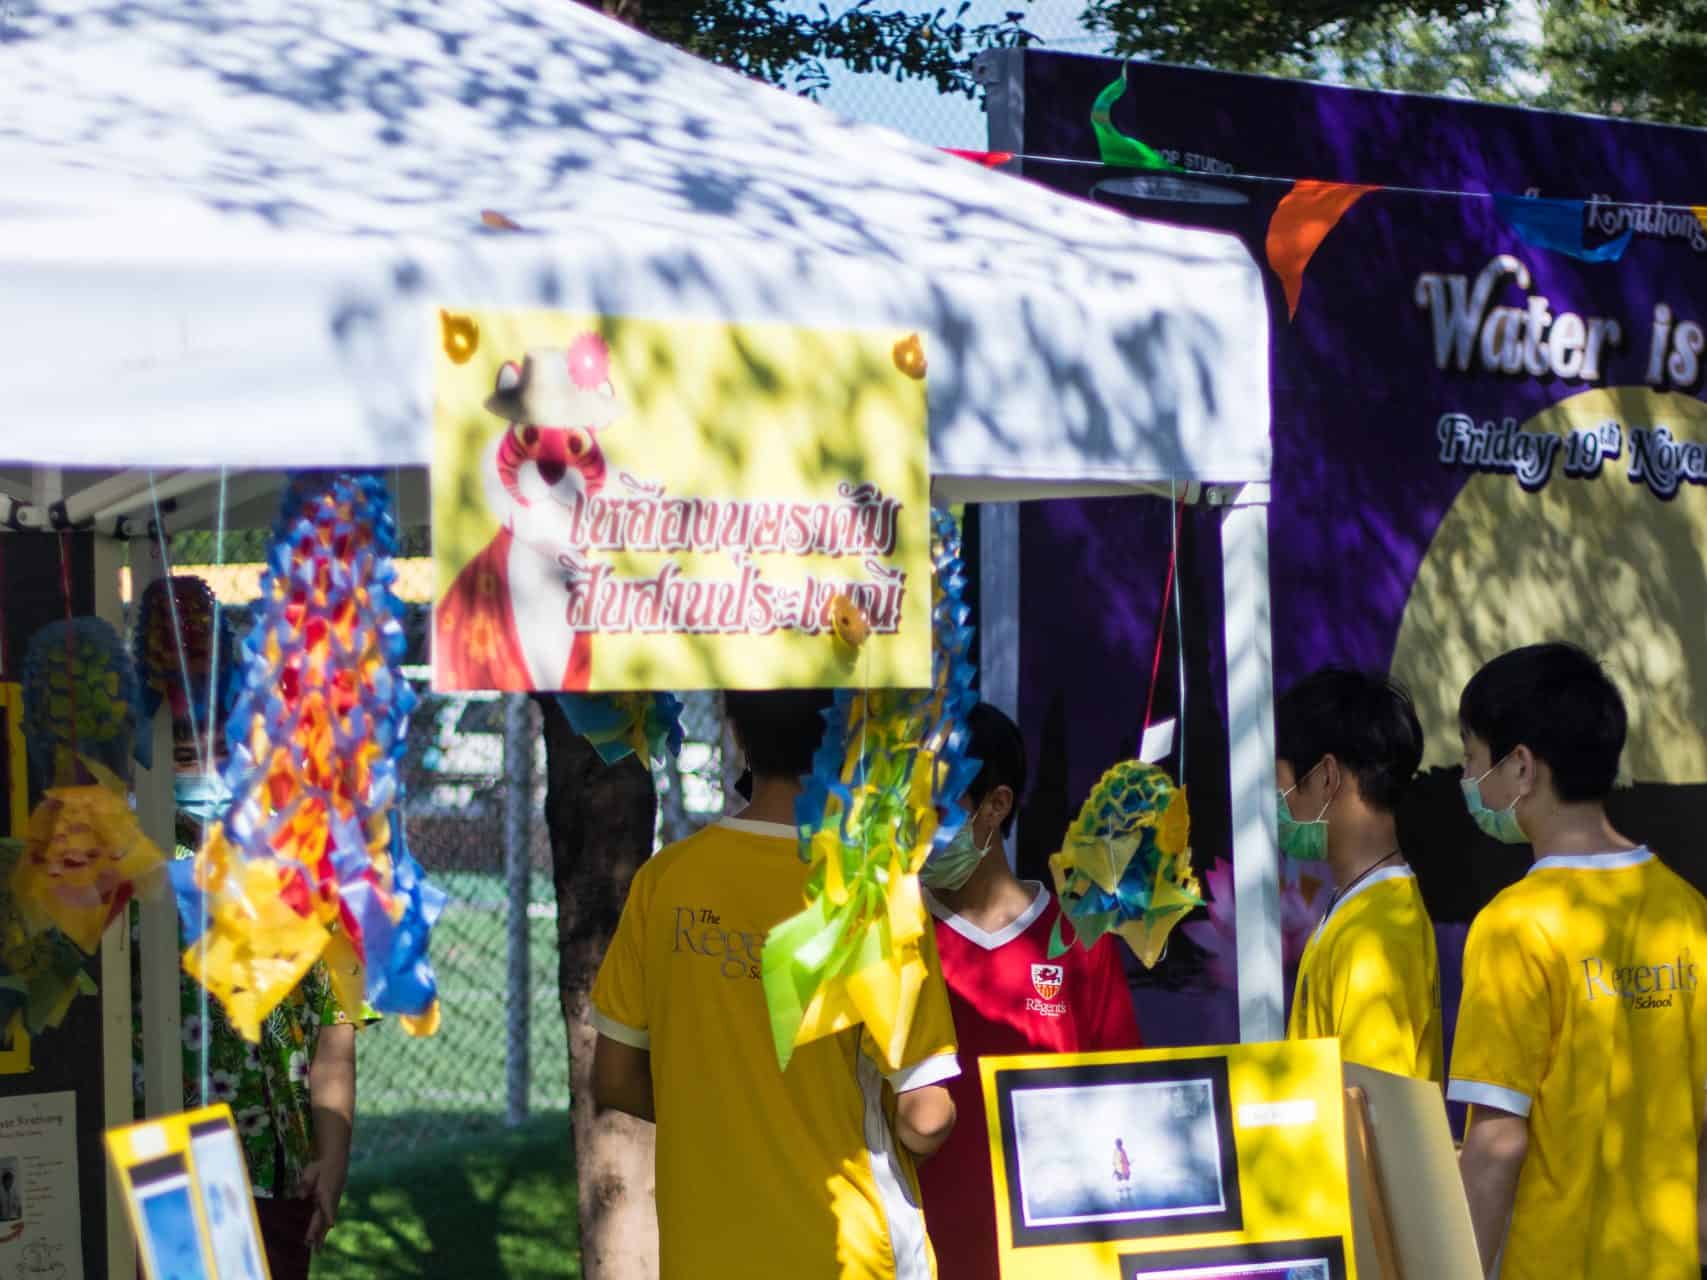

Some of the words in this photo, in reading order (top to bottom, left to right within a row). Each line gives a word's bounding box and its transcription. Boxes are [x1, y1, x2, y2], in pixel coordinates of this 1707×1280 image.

[1415, 254, 1621, 381] Water
[1648, 302, 1704, 386] is
[1439, 412, 1561, 486] Friday
[1565, 418, 1622, 473] 19th
[1628, 424, 1707, 495] Nove
[702, 909, 720, 924] The
[1634, 994, 1672, 1009] School
